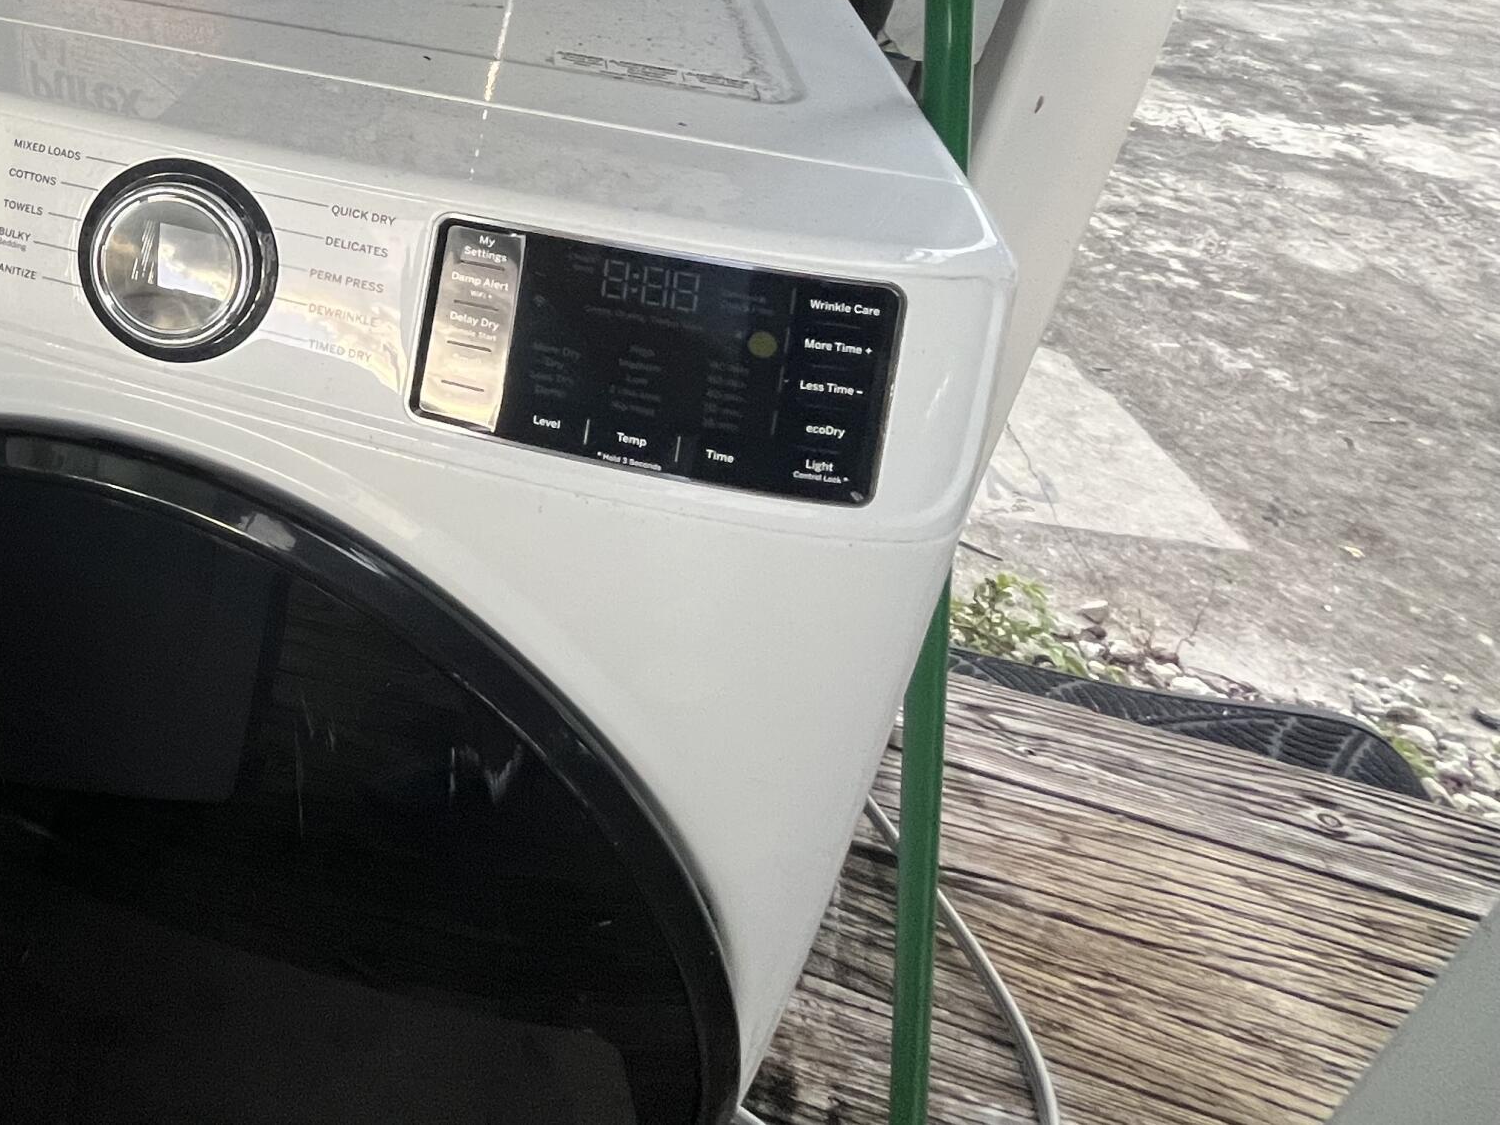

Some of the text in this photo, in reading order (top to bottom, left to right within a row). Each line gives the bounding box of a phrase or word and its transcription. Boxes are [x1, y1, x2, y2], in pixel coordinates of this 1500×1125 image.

[14, 138, 82, 161] MIXED LOADS
[8, 167, 57, 186] COTTONS
[4, 199, 44, 216] TOWELS
[331, 204, 396, 226] QUICK DRY
[325, 236, 389, 258] DELICATES
[479, 235, 496, 248] My
[464, 245, 508, 263] Settings
[309, 268, 385, 293] PERM PRESS
[451, 271, 509, 292] Damp Alert
[308, 303, 380, 328] DEWRINKLE
[810, 299, 881, 316] Wrinkle Care
[449, 310, 479, 327] Delay
[480, 317, 500, 333] Dry
[309, 339, 373, 363] TIMED DRY
[804, 338, 833, 351] More
[834, 341, 863, 355] Time
[799, 380, 825, 392] Less
[826, 383, 855, 395] Time
[533, 415, 561, 429] Level
[616, 431, 648, 448] Temp
[805, 425, 846, 439] ecoDry
[602, 452, 662, 472] Hold 3 Seconds
[705, 448, 735, 464] Time
[805, 459, 835, 473] Light
[792, 470, 842, 484] Control Lock
